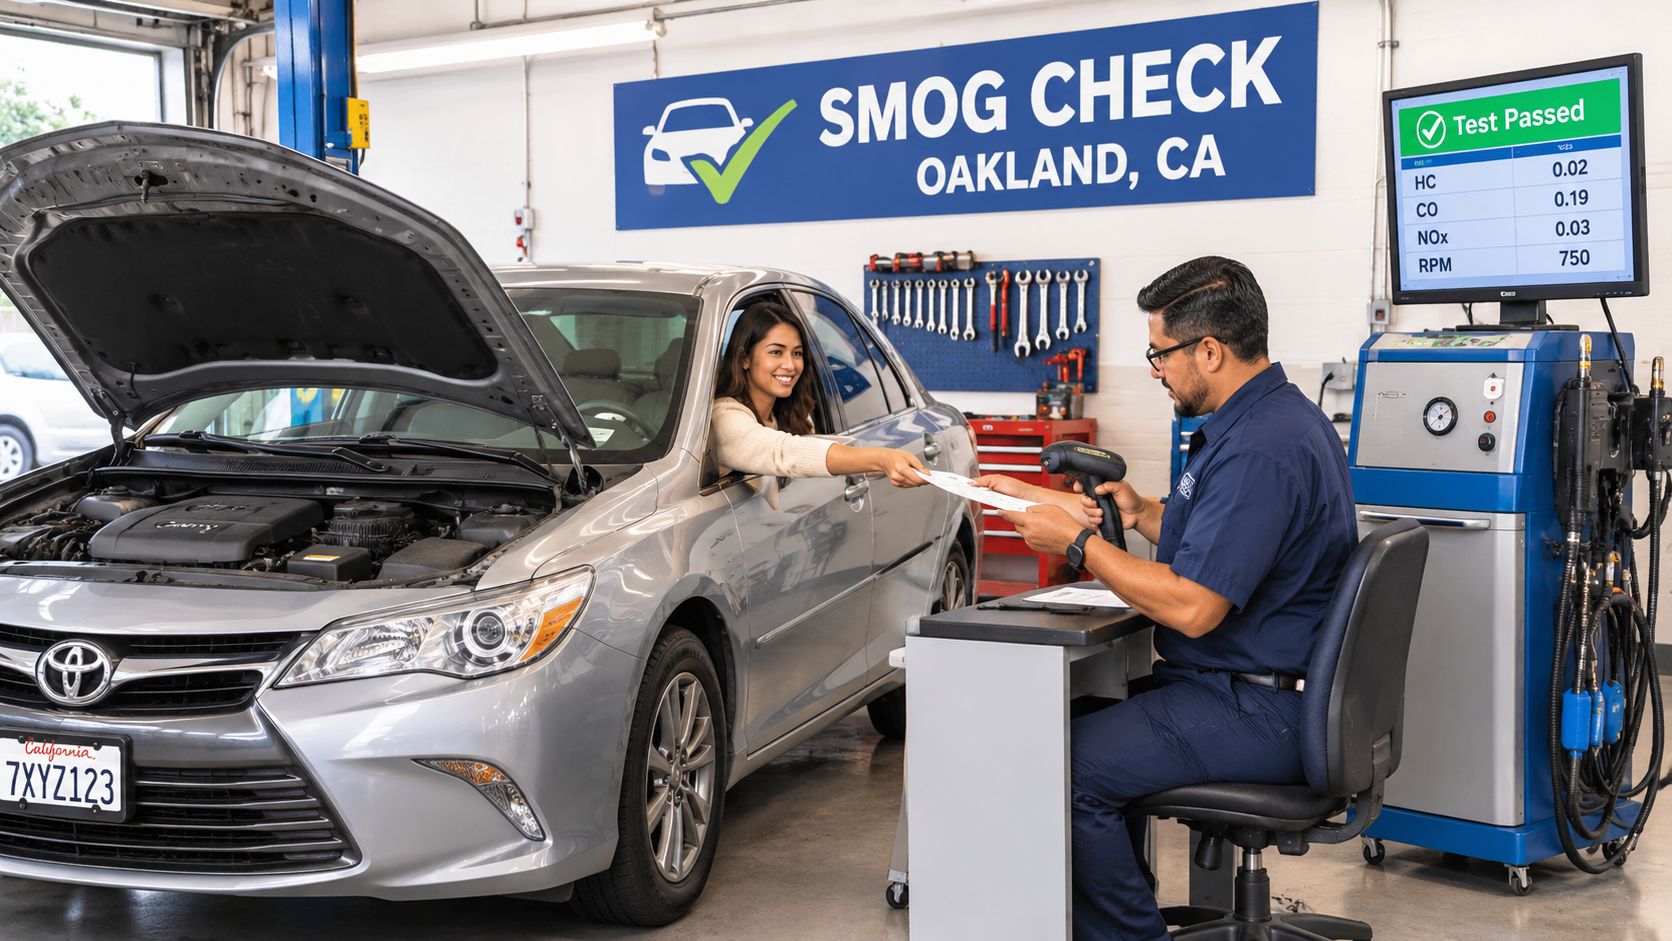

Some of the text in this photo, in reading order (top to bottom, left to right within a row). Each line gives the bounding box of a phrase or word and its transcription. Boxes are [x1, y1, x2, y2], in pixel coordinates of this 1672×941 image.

[820, 36, 1281, 146] SMOG CHECK
[1453, 98, 1585, 135] Test Passed
[917, 135, 1226, 195] OAKLAND, CA
[1415, 159, 1588, 190] HC 0.02
[1416, 189, 1589, 217] CO 0.19
[1418, 219, 1590, 245] NOx 0.03
[1419, 249, 1590, 273] RPM 750
[25, 739, 95, 762] California
[6, 760, 114, 805] 7XYZ123
